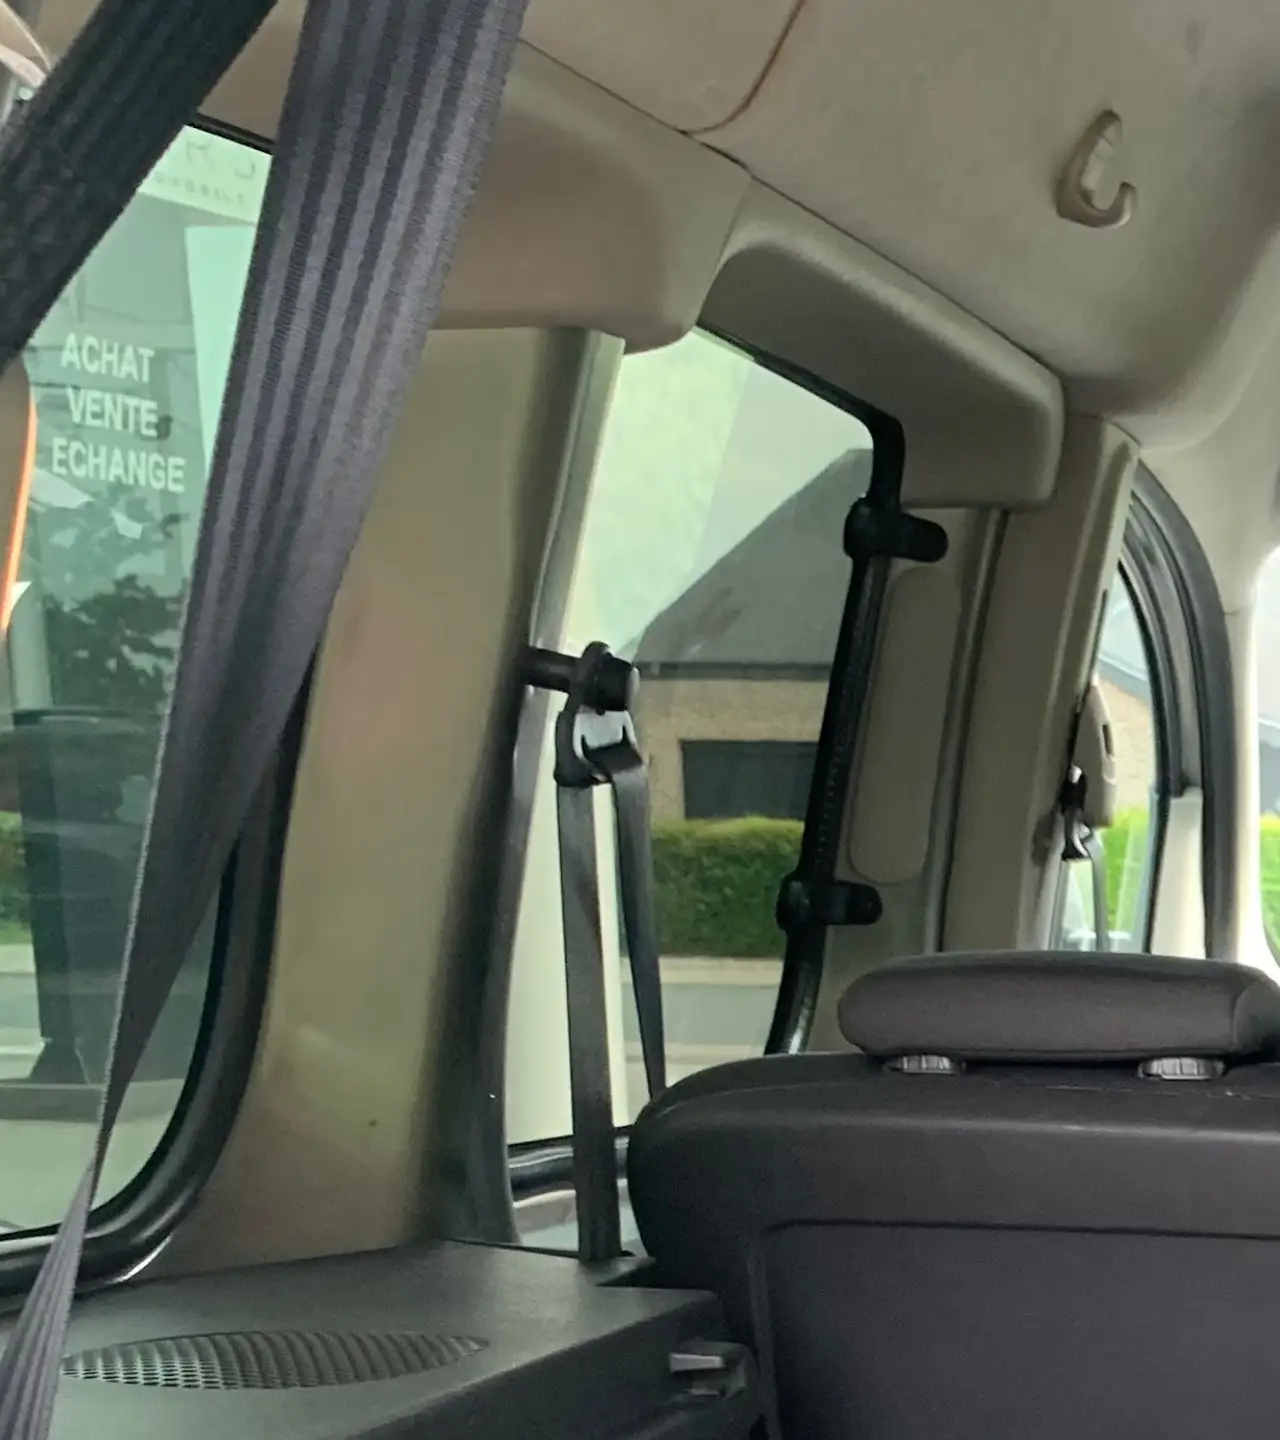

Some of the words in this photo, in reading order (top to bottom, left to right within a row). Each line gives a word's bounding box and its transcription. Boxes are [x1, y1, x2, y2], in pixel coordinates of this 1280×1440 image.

[60, 332, 155, 383] ACHAT
[66, 386, 158, 437] VENTE
[51, 436, 186, 493] ECHANGE
